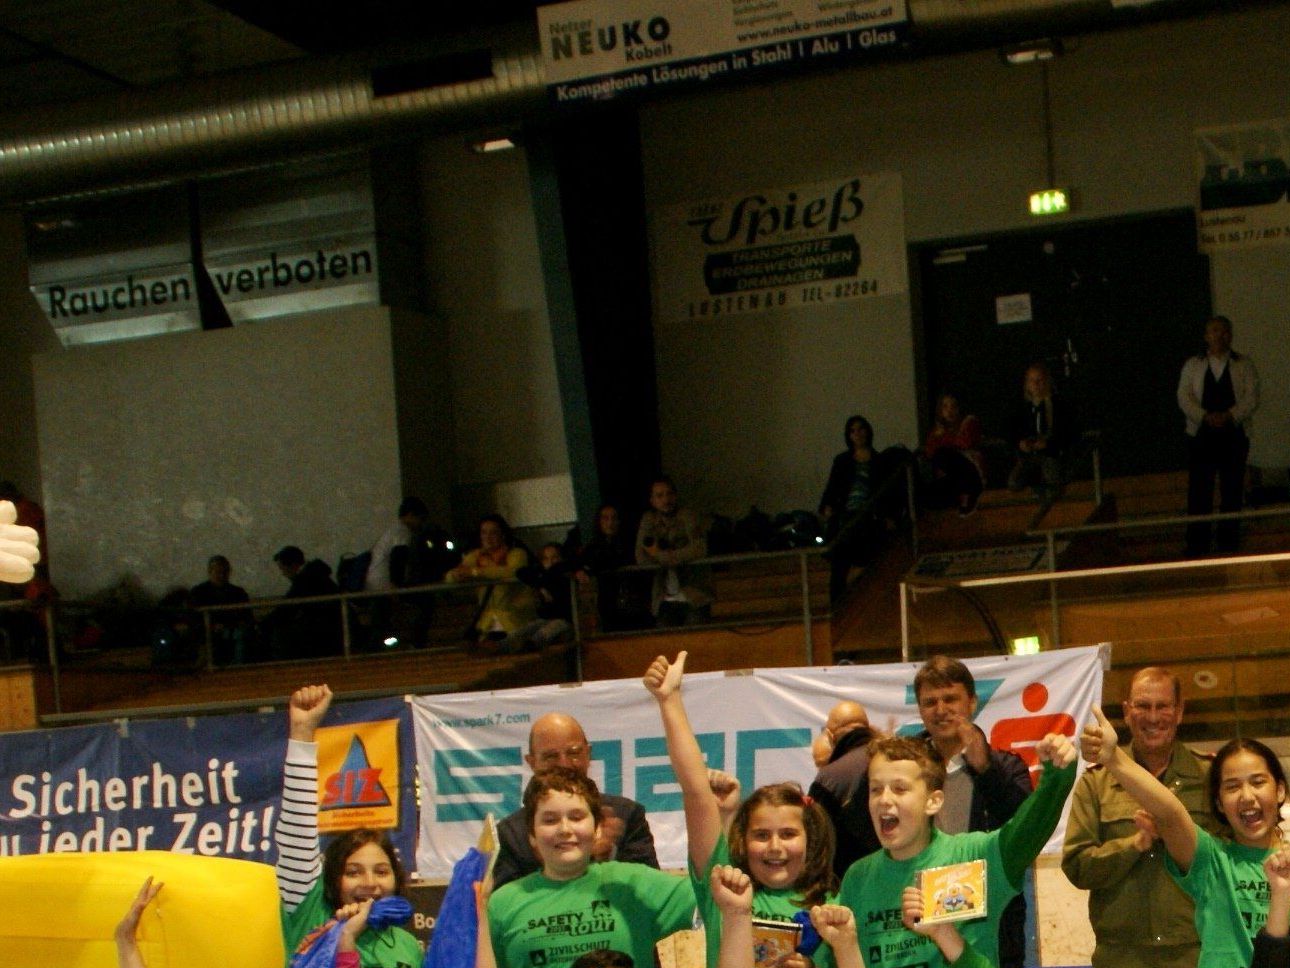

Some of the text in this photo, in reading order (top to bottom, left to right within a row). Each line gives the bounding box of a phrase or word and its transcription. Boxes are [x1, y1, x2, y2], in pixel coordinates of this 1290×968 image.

[551, 17, 670, 60] NEUKO
[738, 7, 892, 41] www.neuko-metallbau.at
[556, 72, 649, 101] Kompetente
[653, 57, 728, 84] Lösungen
[732, 53, 746, 70] in
[751, 44, 791, 66] Stahl
[811, 36, 839, 57] Alu
[858, 29, 897, 48] Glas
[688, 180, 863, 244] Spieß
[48, 249, 373, 319] Rauchen verboten
[8, 757, 242, 819] Sicherheit
[321, 768, 384, 805] SIZ
[170, 805, 274, 855] Zeit!
[1237, 880, 1271, 892] SAFE
[414, 912, 436, 929] Bo
[527, 912, 584, 930] SAFETY
[867, 908, 903, 923] SAFE
[885, 935, 933, 953] ZIVILSCHUT
